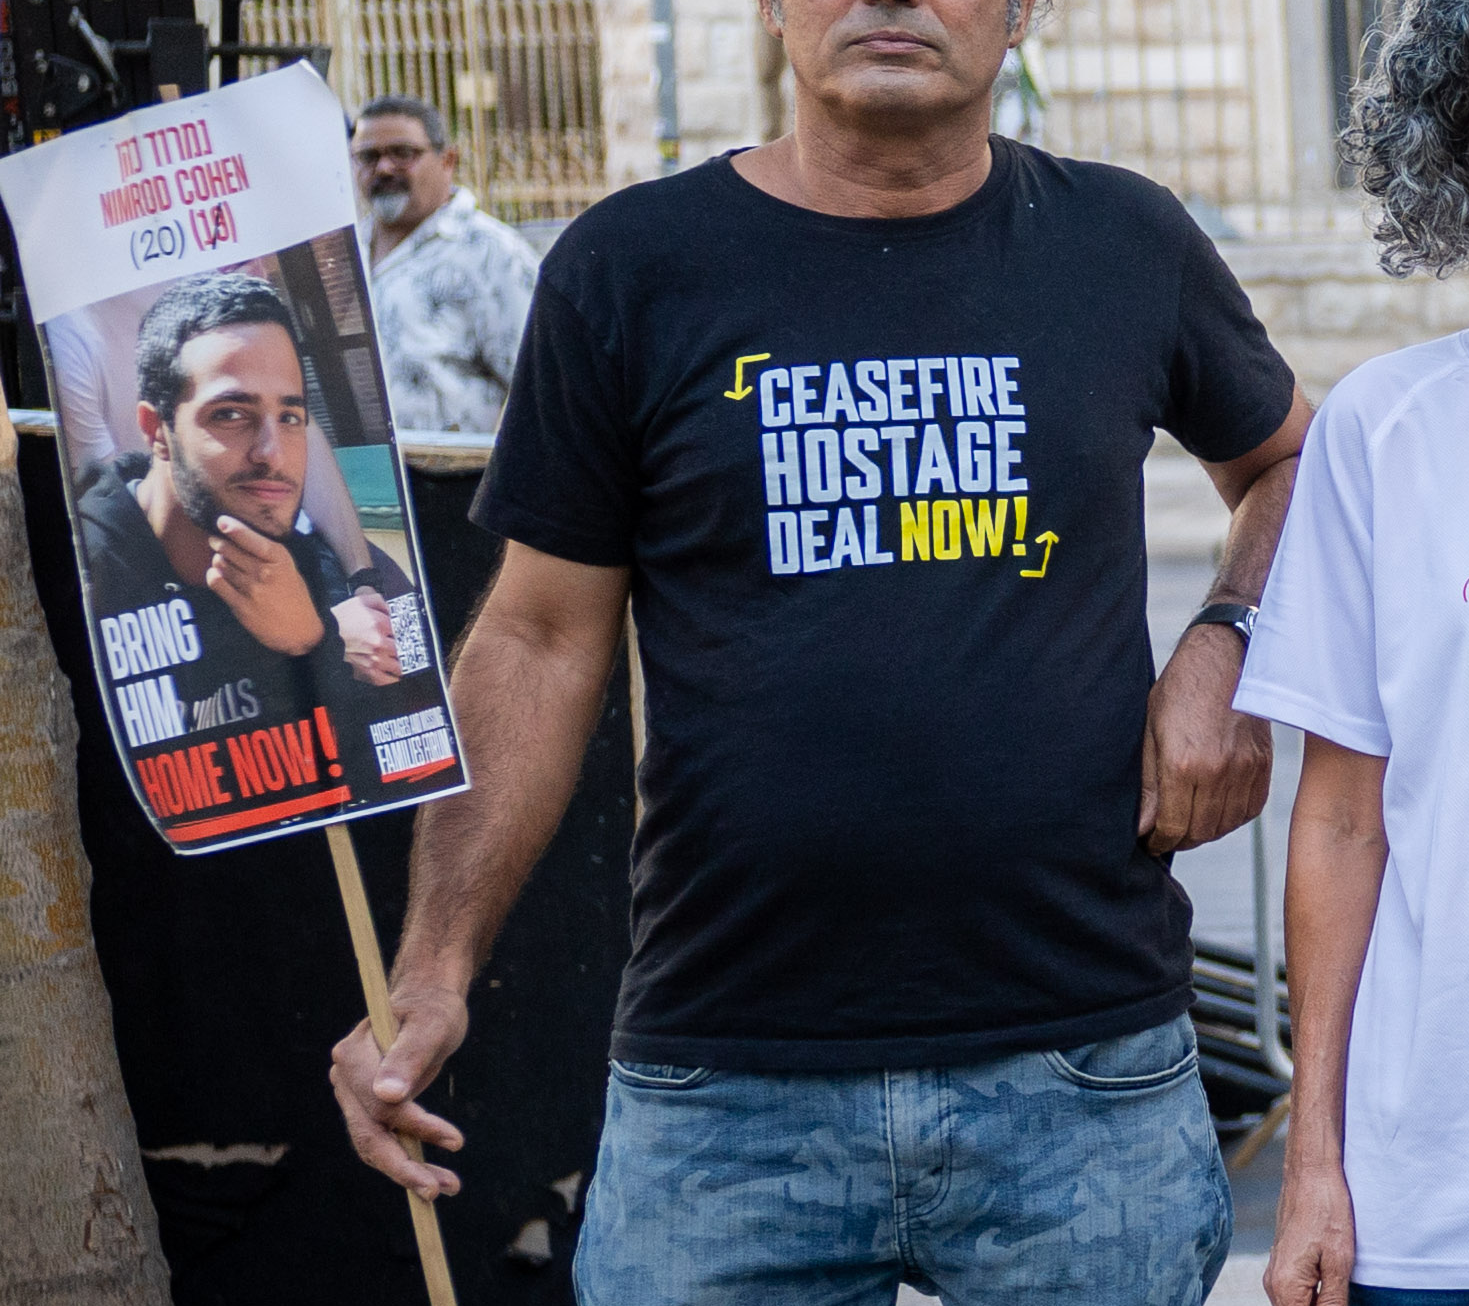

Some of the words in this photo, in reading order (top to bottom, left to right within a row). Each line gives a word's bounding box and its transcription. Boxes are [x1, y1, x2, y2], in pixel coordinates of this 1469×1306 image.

[144, 118, 213, 167] נמרוד
[100, 174, 172, 228] NIMROD
[174, 153, 250, 206] COHEN
[130, 219, 185, 270] (20)
[760, 356, 1026, 428] CEASEFIRE
[762, 420, 1028, 506] HOSTAGE
[768, 504, 894, 575] DEAL
[900, 496, 1028, 562] NOW!
[100, 598, 201, 680] BRING
[116, 674, 187, 748] HIM
[136, 742, 232, 819] HOME
[226, 706, 344, 798] NOW!
